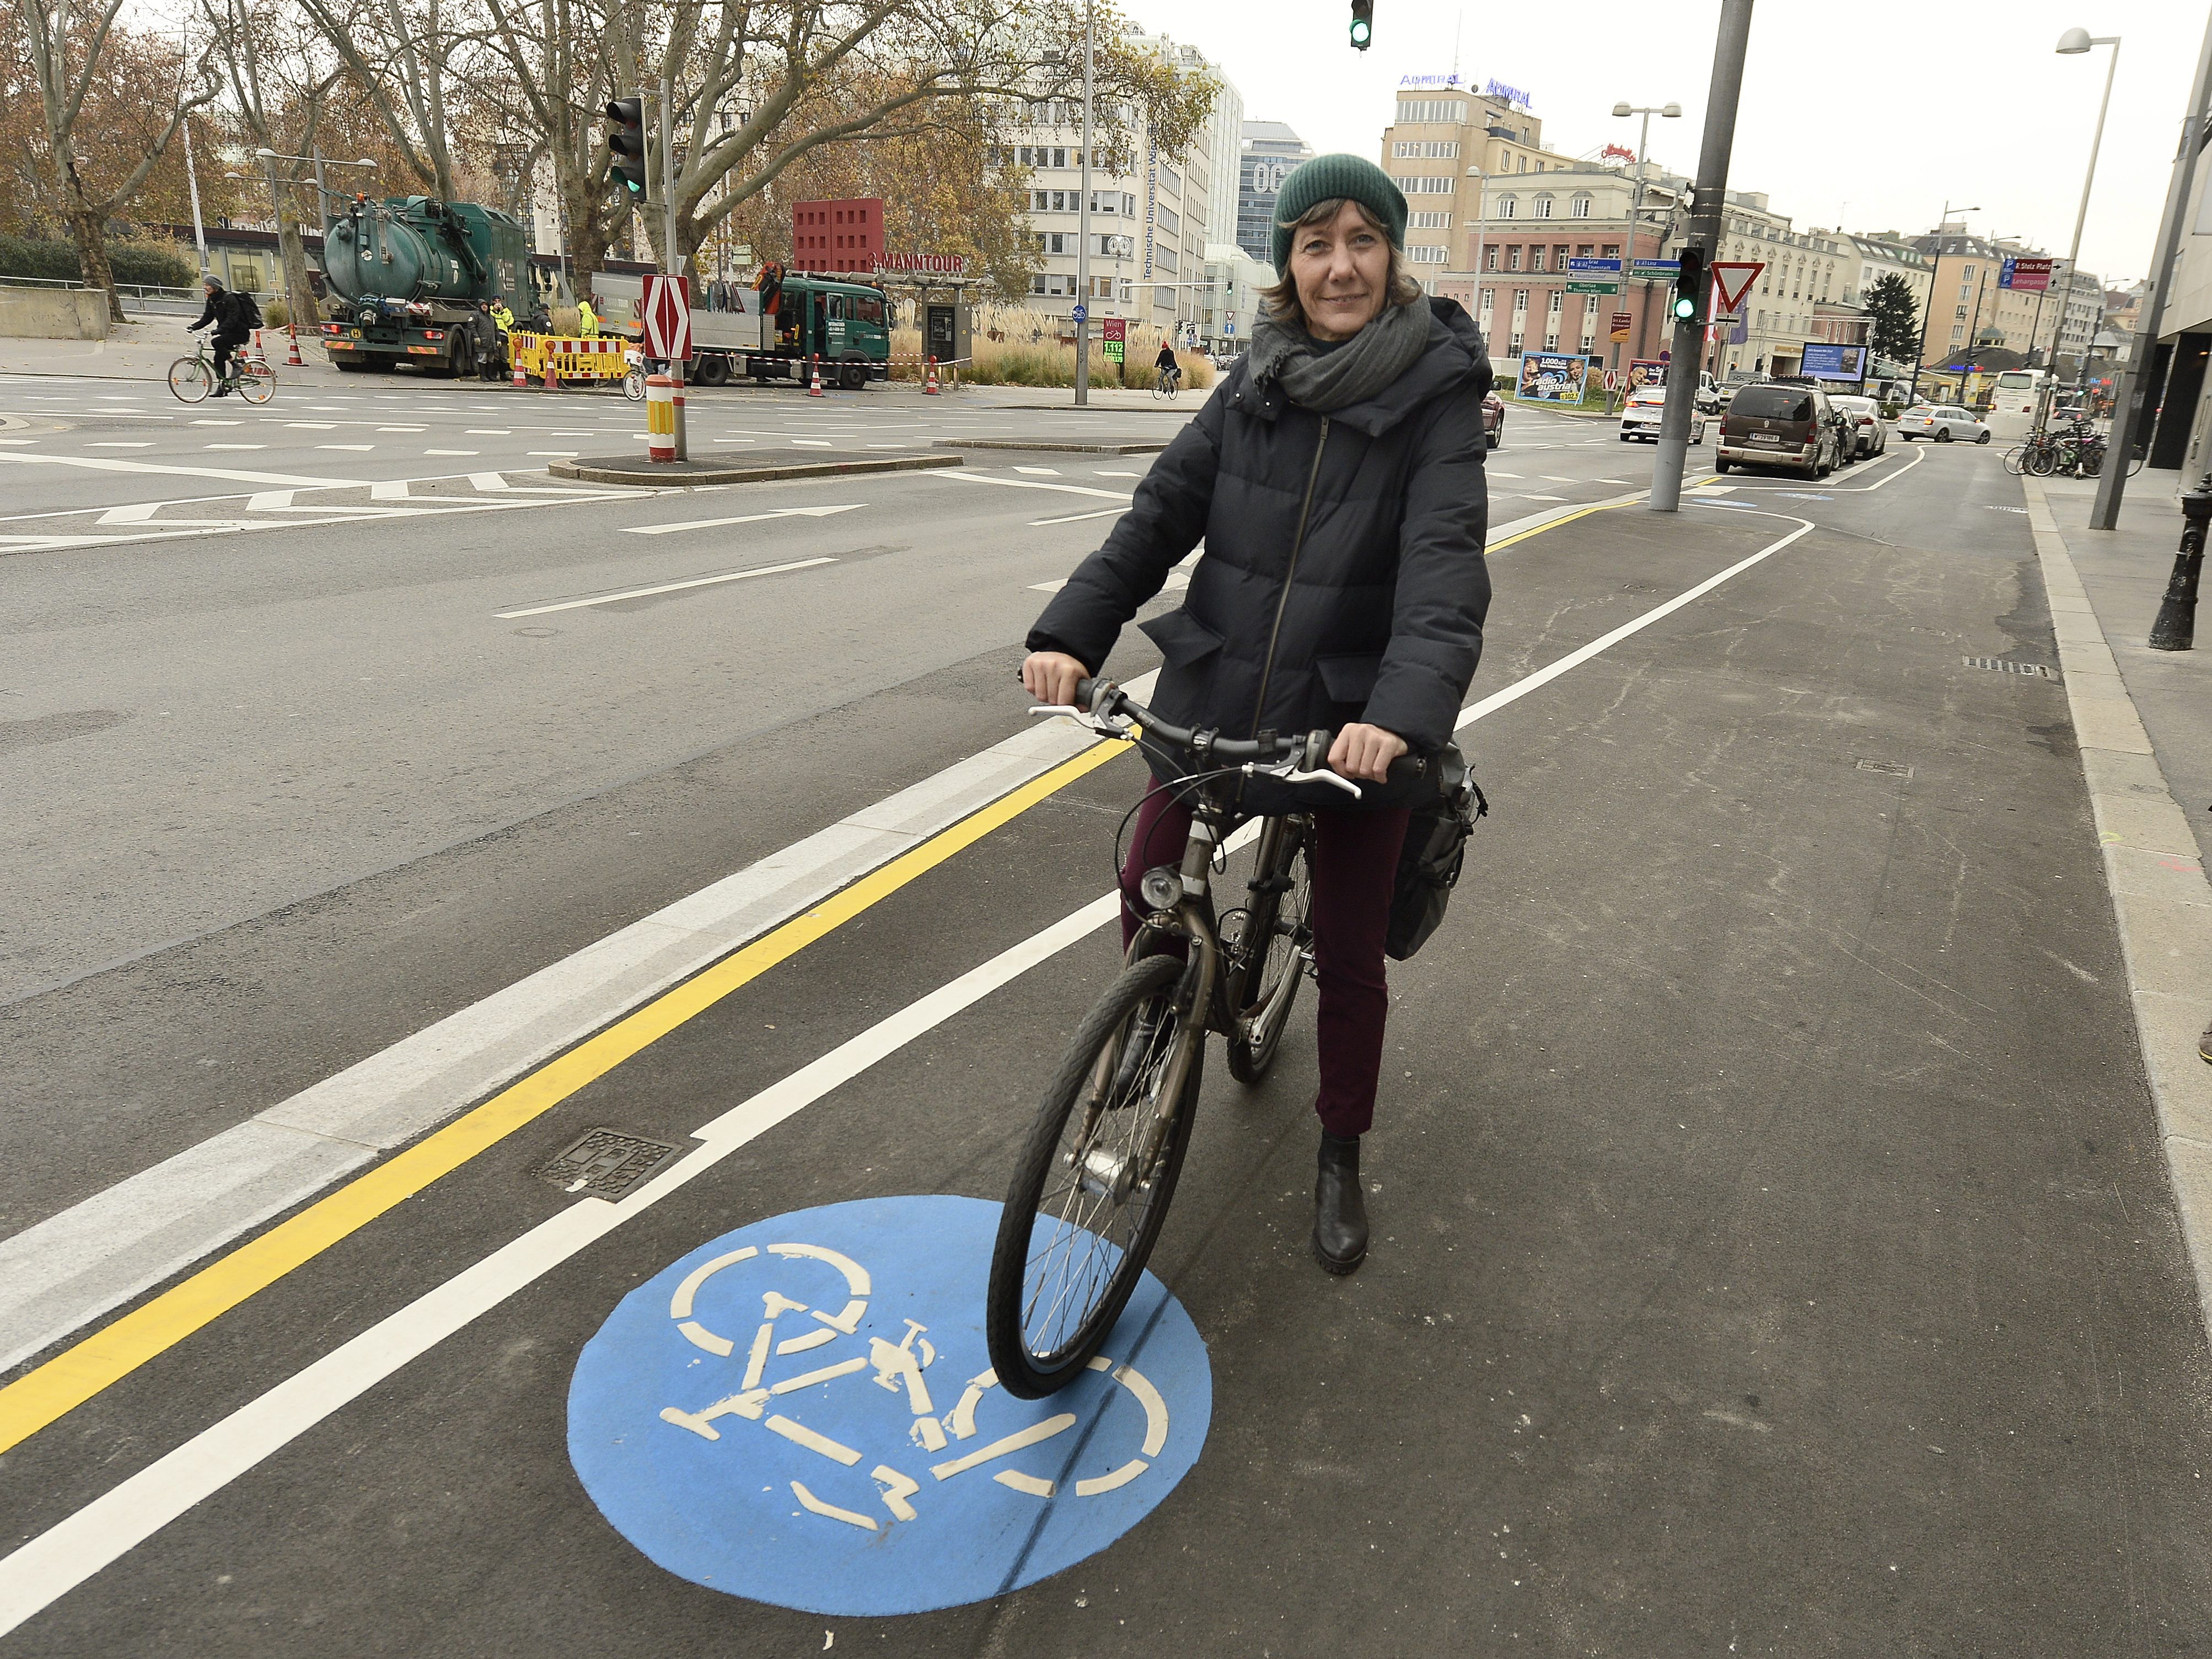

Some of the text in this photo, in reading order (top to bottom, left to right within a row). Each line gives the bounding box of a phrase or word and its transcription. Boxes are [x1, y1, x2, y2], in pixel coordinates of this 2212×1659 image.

[1400, 74, 1464, 85] ADMIRAL
[1486, 77, 1533, 109] ADMIRAL
[1148, 138, 1157, 165] Wien
[1146, 168, 1156, 223] Universität
[1143, 227, 1154, 280] Technische
[1104, 343, 1123, 352] 1.112
[1532, 377, 1557, 385] radio
[1537, 383, 1571, 391] austria
